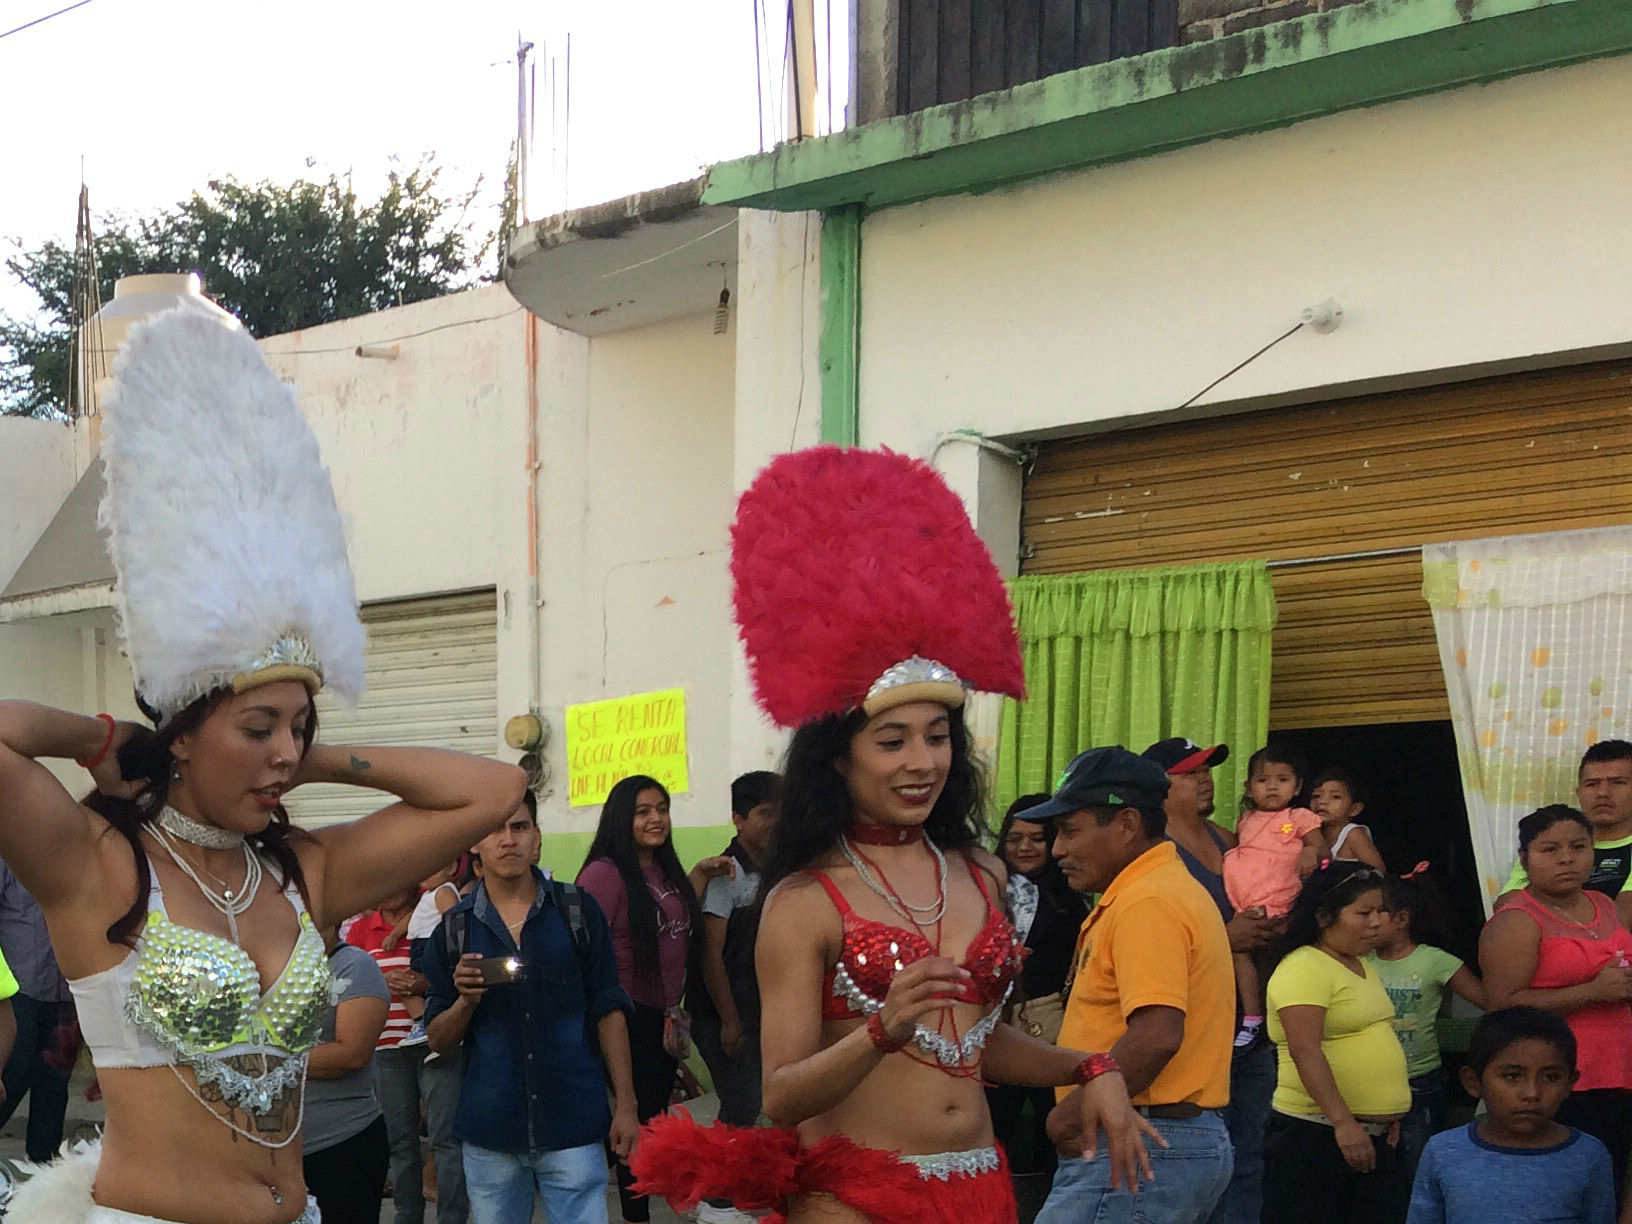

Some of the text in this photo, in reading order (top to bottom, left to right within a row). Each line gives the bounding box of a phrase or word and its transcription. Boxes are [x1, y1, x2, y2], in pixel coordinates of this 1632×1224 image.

[577, 698, 675, 742] SE RENTA
[572, 743, 614, 771] LOCAL
